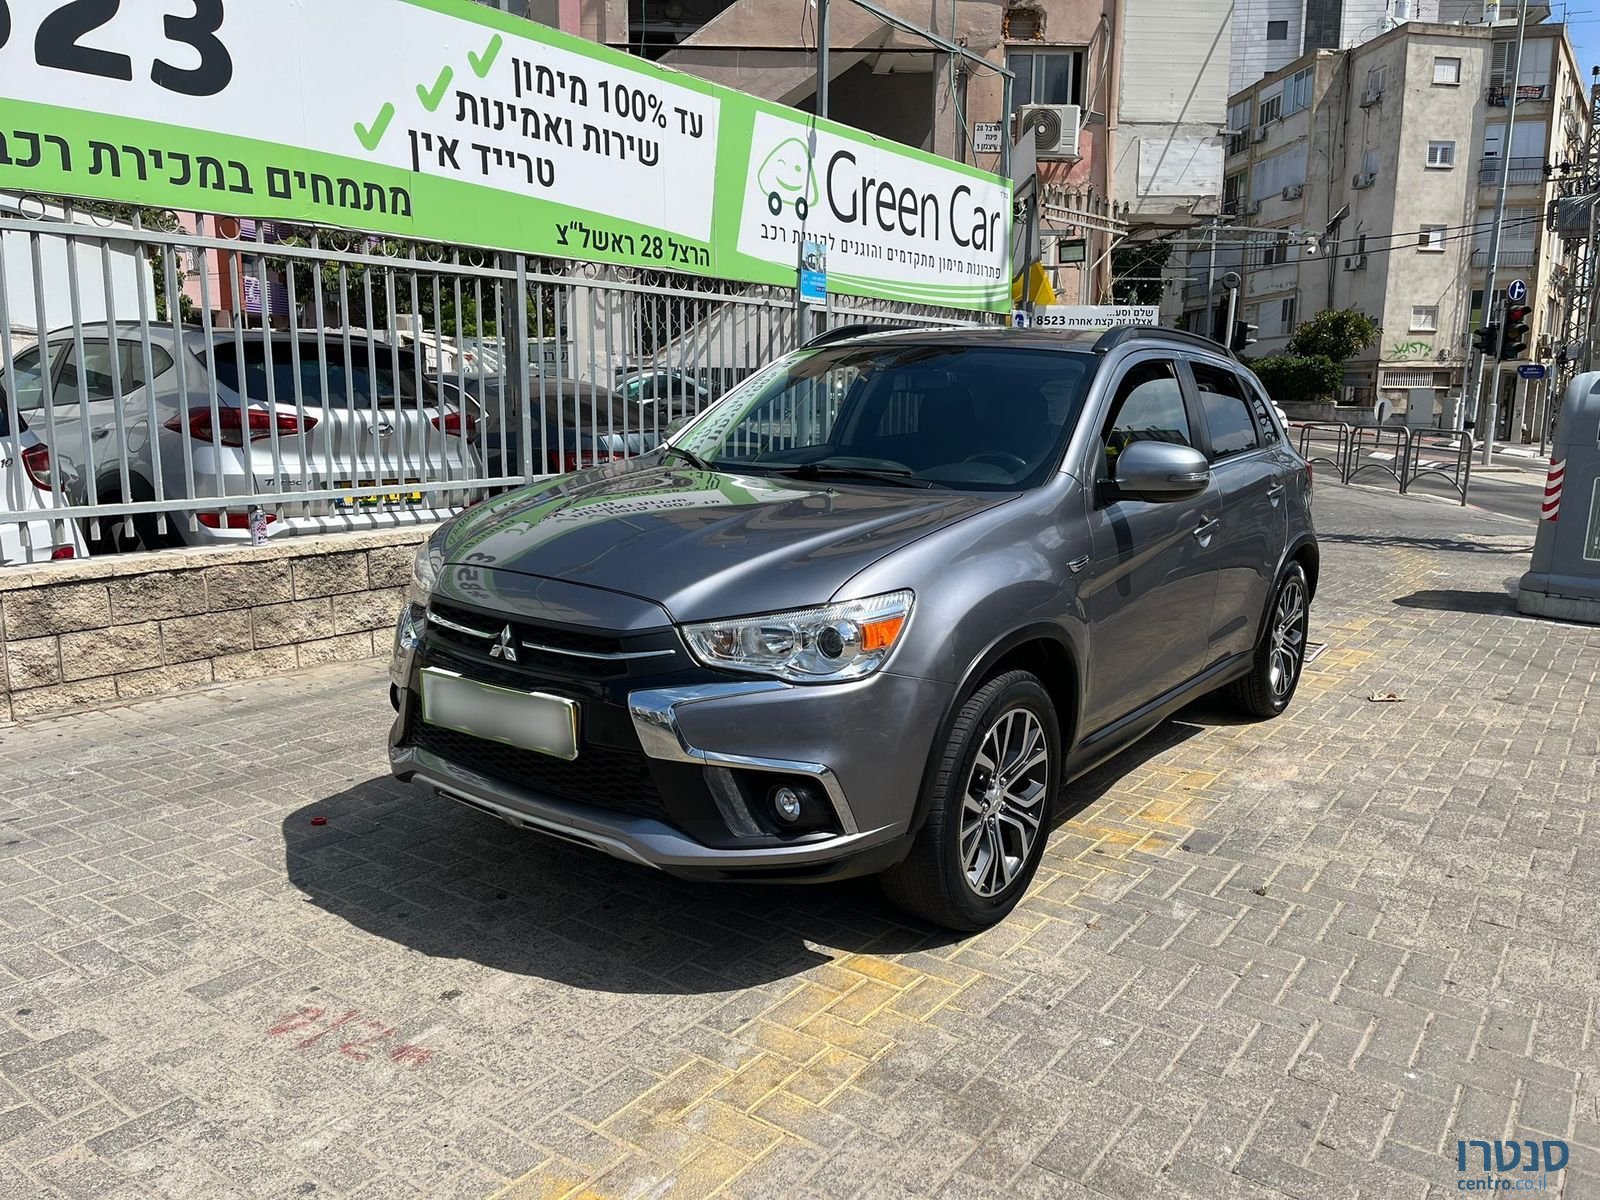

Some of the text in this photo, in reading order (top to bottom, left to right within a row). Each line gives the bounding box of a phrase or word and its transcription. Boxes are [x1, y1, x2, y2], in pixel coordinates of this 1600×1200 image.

[0, 0, 233, 96] 23
[512, 57, 703, 138] עד 100% מימון
[455, 90, 659, 166] שירות ואמינות
[88, 139, 254, 194] במכירת
[408, 129, 555, 188] טרייד אין
[266, 165, 411, 217] מתמחים
[826, 150, 1000, 252] Green Car
[761, 223, 786, 243] רכב
[640, 234, 663, 259] 28
[668, 237, 710, 267] הרצל
[841, 239, 882, 259] והוגנים
[887, 247, 935, 269] מתקדמים
[939, 257, 963, 273] מימון
[966, 262, 1001, 279] פתרונות
[1034, 315, 1065, 325] 8523
[1068, 318, 1093, 326] אחרת
[1094, 318, 1114, 327] קצת
